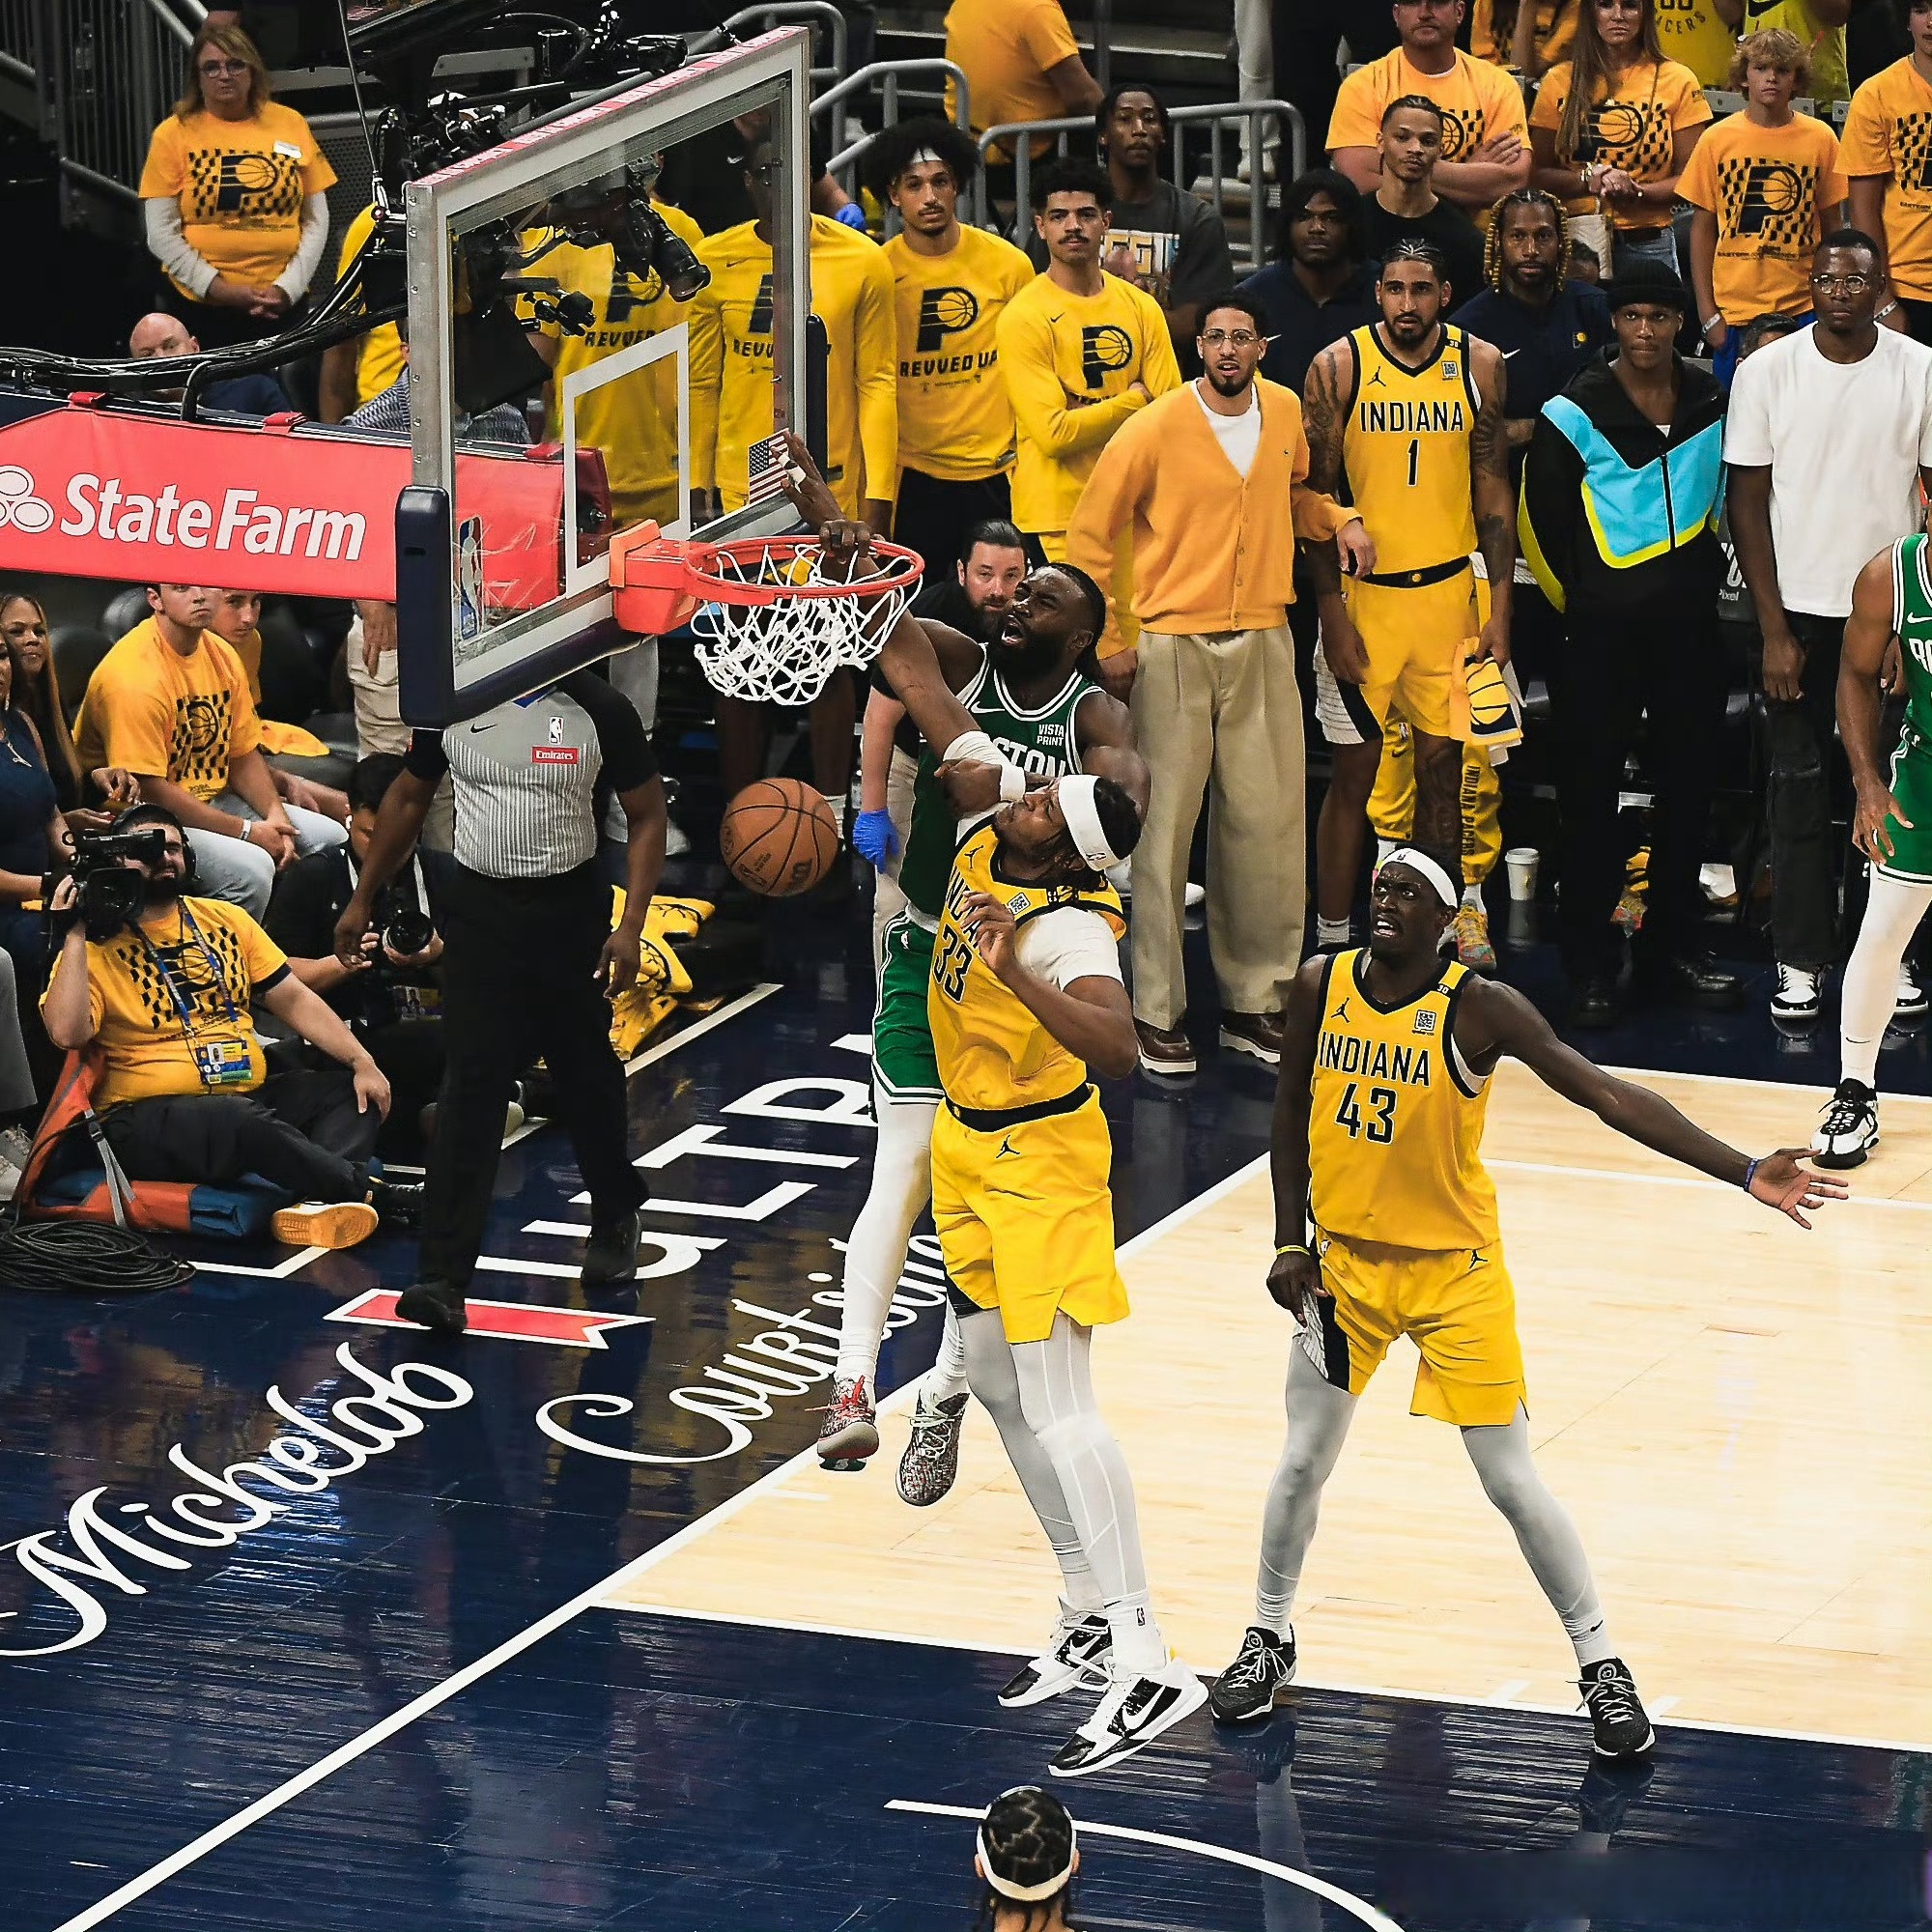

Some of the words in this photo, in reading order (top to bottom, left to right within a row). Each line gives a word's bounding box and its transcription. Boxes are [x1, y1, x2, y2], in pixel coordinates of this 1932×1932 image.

[1657, 11, 1707, 35] CERS
[733, 338, 774, 358] REVV
[899, 354, 975, 378] REVVED
[1360, 401, 1464, 434] INDIANA
[1406, 438, 1420, 488] 1
[1036, 735, 1065, 747] PRINT
[1037, 724, 1065, 737] VISTA
[535, 750, 575, 761] Emirates
[1461, 764, 1481, 813] INDIANA
[932, 923, 974, 1005] 33
[1318, 1031, 1432, 1088] INDIANA
[1335, 1081, 1399, 1146] 43
[0, 1342, 474, 1657] Michelob
